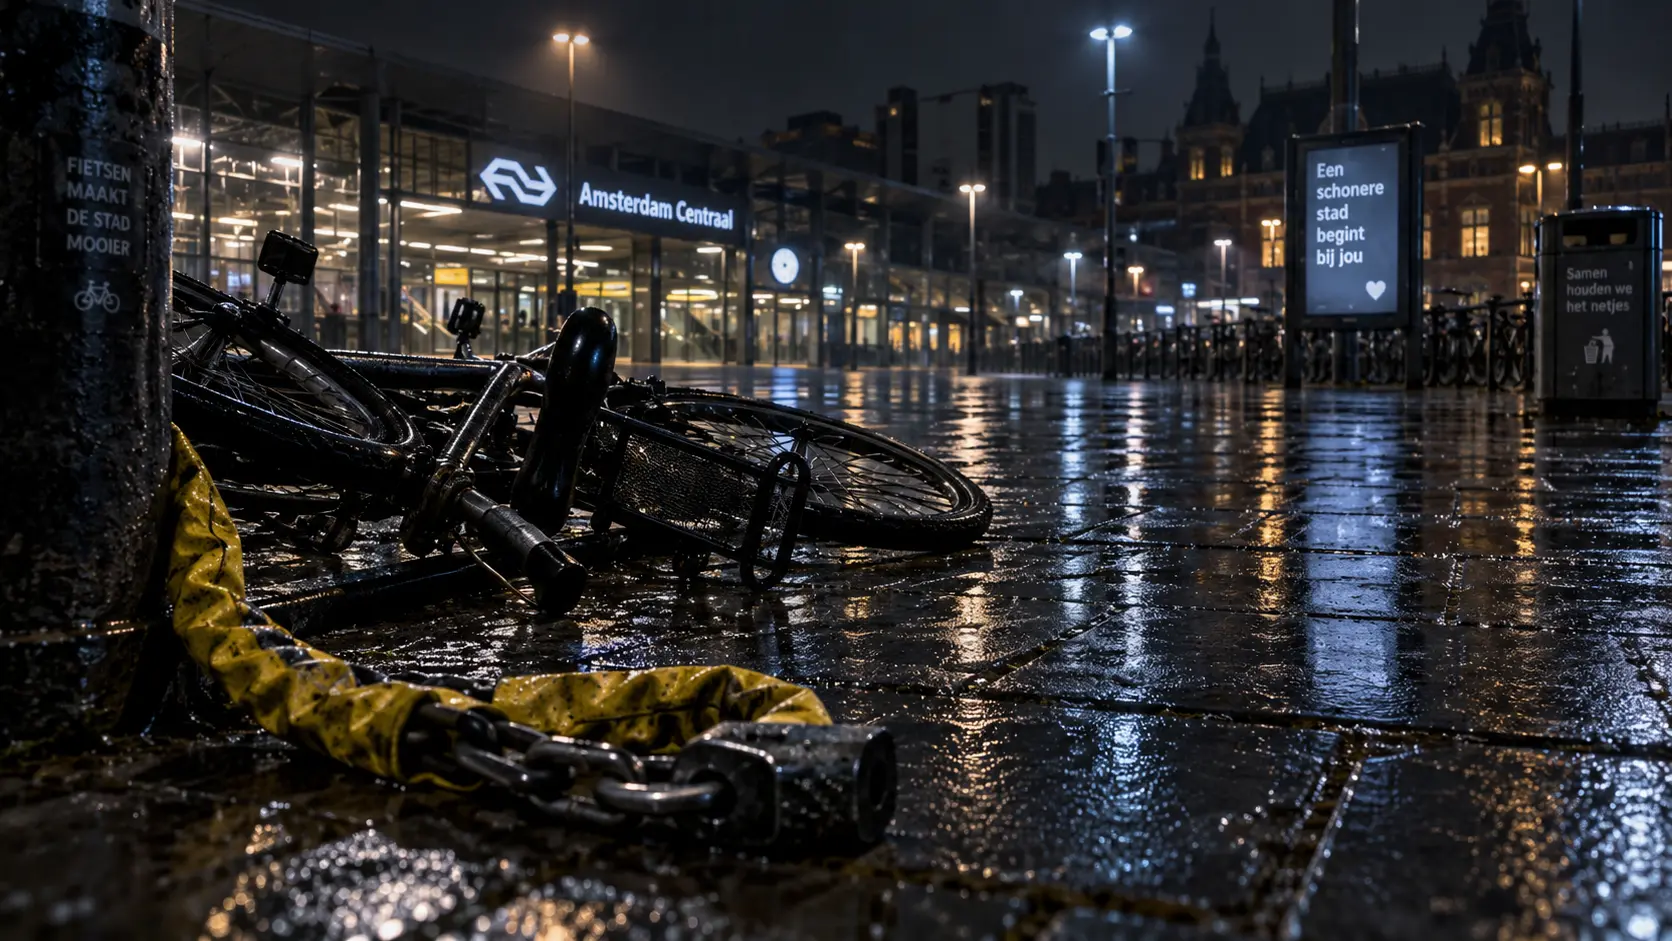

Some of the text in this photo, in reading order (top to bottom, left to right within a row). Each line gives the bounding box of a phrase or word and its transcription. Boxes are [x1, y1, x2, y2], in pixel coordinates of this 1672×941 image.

[67, 156, 132, 183] FIETSEN
[1317, 162, 1344, 179] Een
[67, 181, 129, 206] MAAKT
[1316, 182, 1385, 199] schonere
[578, 181, 734, 231] Amsterdam Centraal
[1316, 203, 1349, 221] stad
[67, 207, 131, 231] DE STAD
[66, 233, 131, 257] MOOIER
[1317, 225, 1365, 246] begint
[1317, 248, 1364, 268] bij jou
[1566, 267, 1608, 281] Samen
[1566, 282, 1633, 297] houden we
[1566, 298, 1631, 316] het netjes
